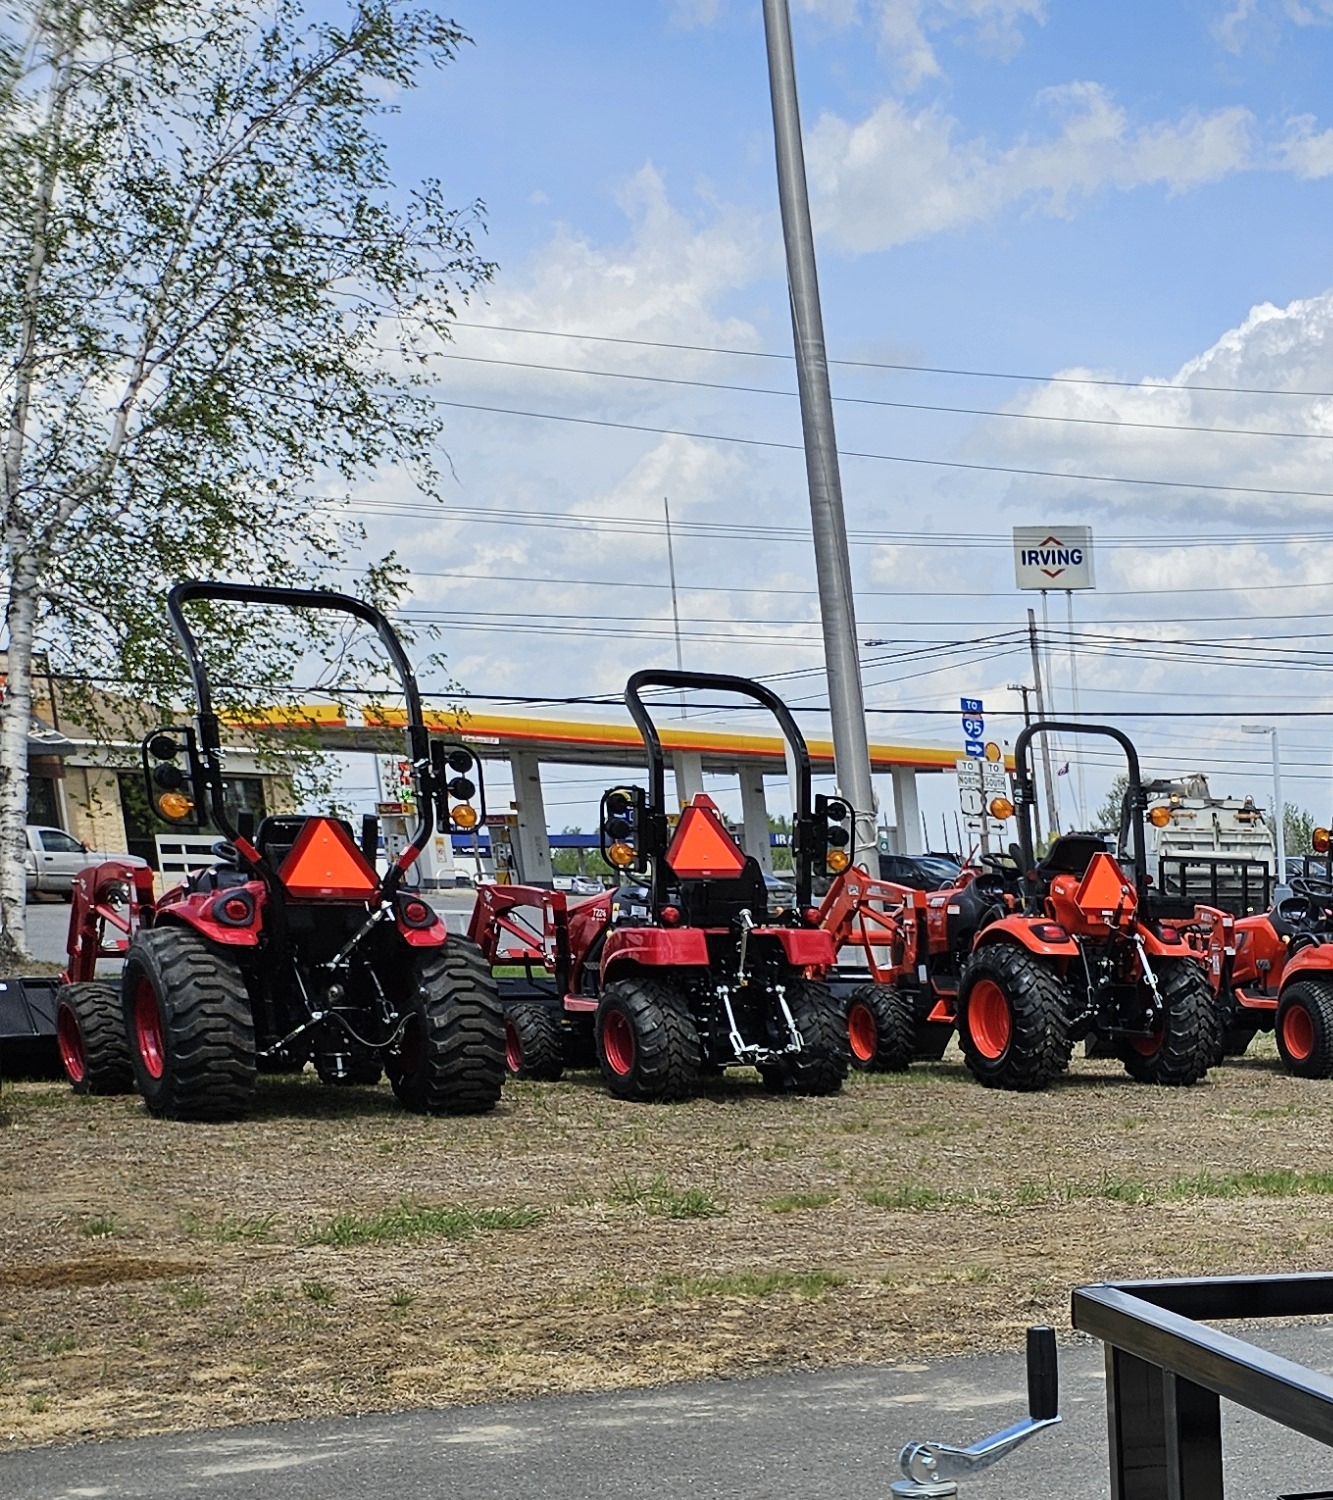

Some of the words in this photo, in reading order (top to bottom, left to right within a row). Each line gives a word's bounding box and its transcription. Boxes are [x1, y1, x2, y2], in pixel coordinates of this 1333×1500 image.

[1021, 549, 1083, 566] IRVING
[965, 700, 978, 710] TO
[965, 721, 982, 735] 95
[962, 762, 974, 771] TO
[988, 764, 1000, 772] TO
[959, 776, 981, 785] NORTH
[985, 777, 1005, 787] SOUTH
